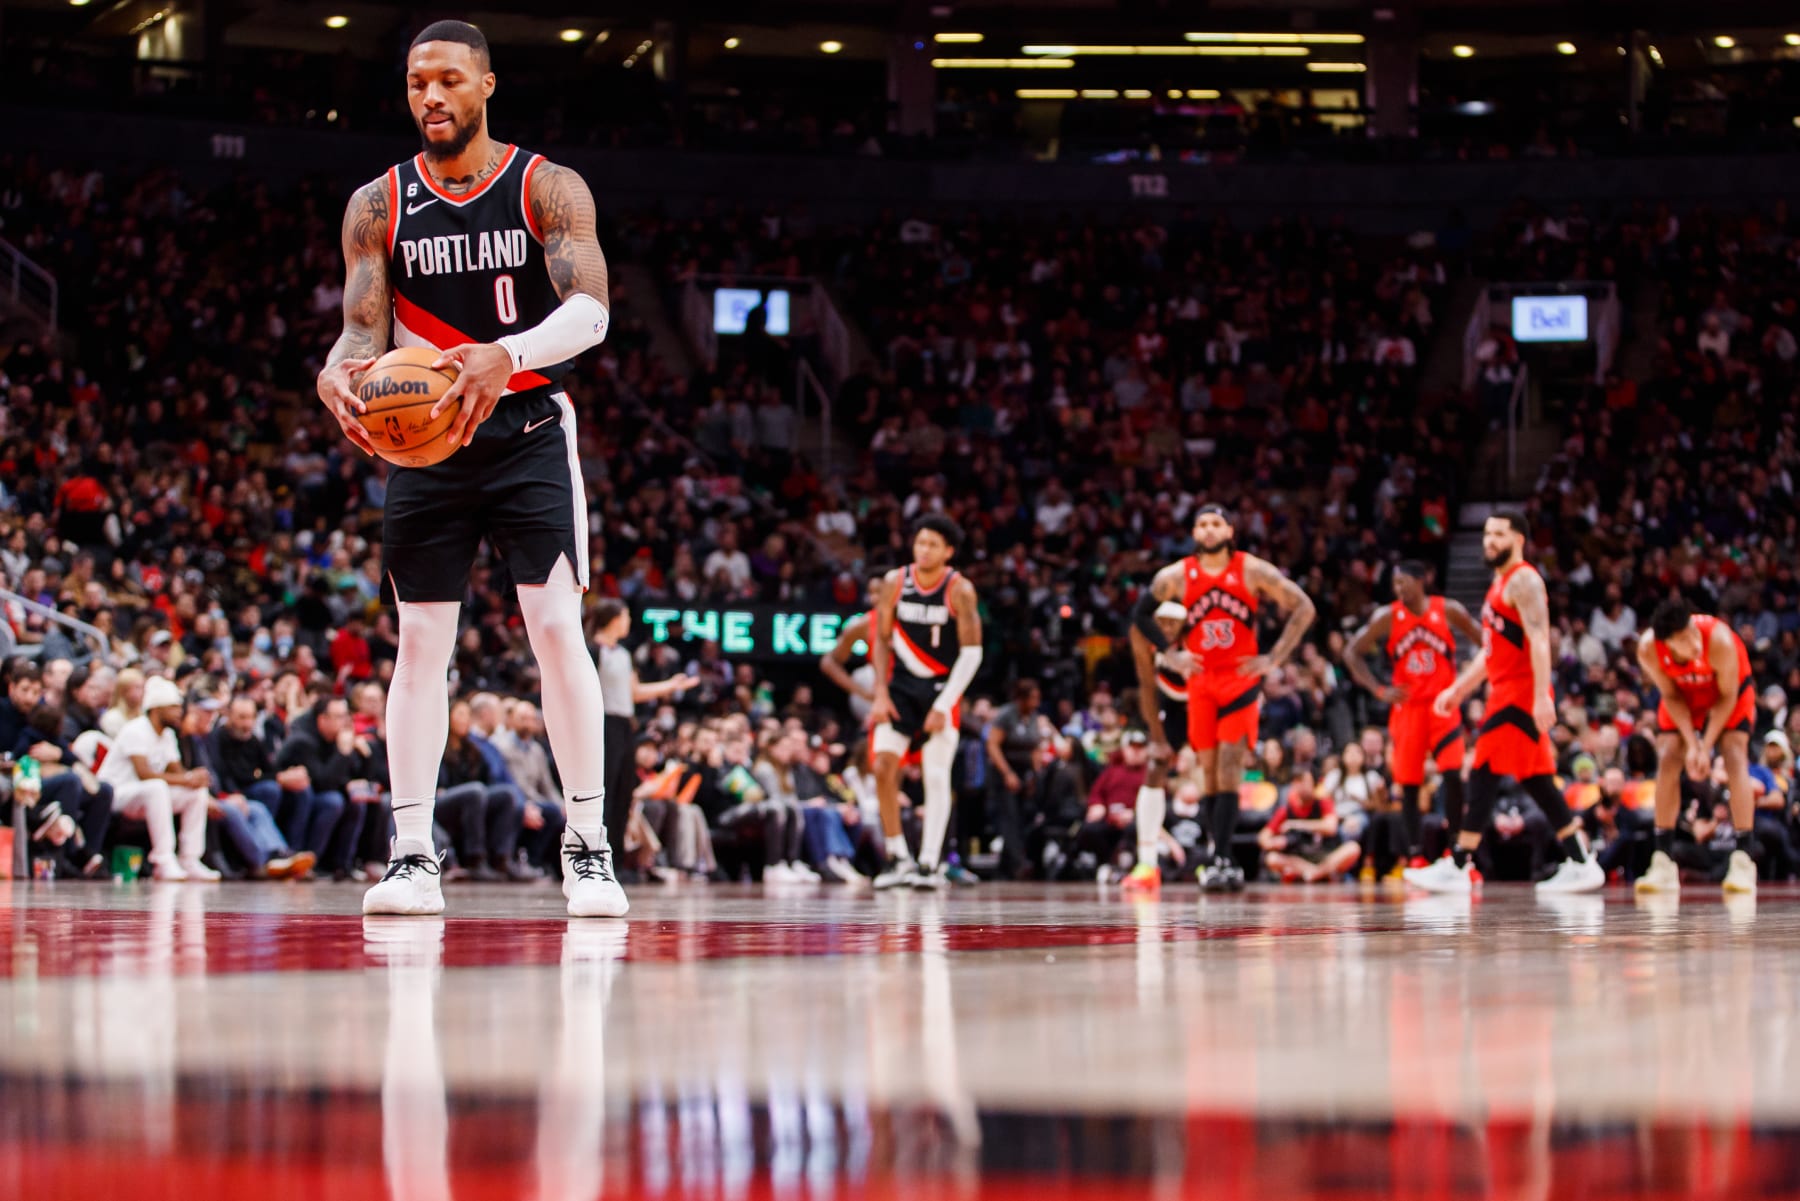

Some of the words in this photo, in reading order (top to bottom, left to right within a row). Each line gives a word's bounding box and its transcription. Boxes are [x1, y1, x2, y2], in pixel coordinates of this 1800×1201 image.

[406, 182, 418, 198] 6
[399, 229, 527, 278] PORTLAND
[494, 274, 518, 325] 0
[360, 376, 430, 403] Wilson
[642, 609, 755, 653] THE
[931, 624, 941, 648] 1
[1201, 619, 1235, 650] 33
